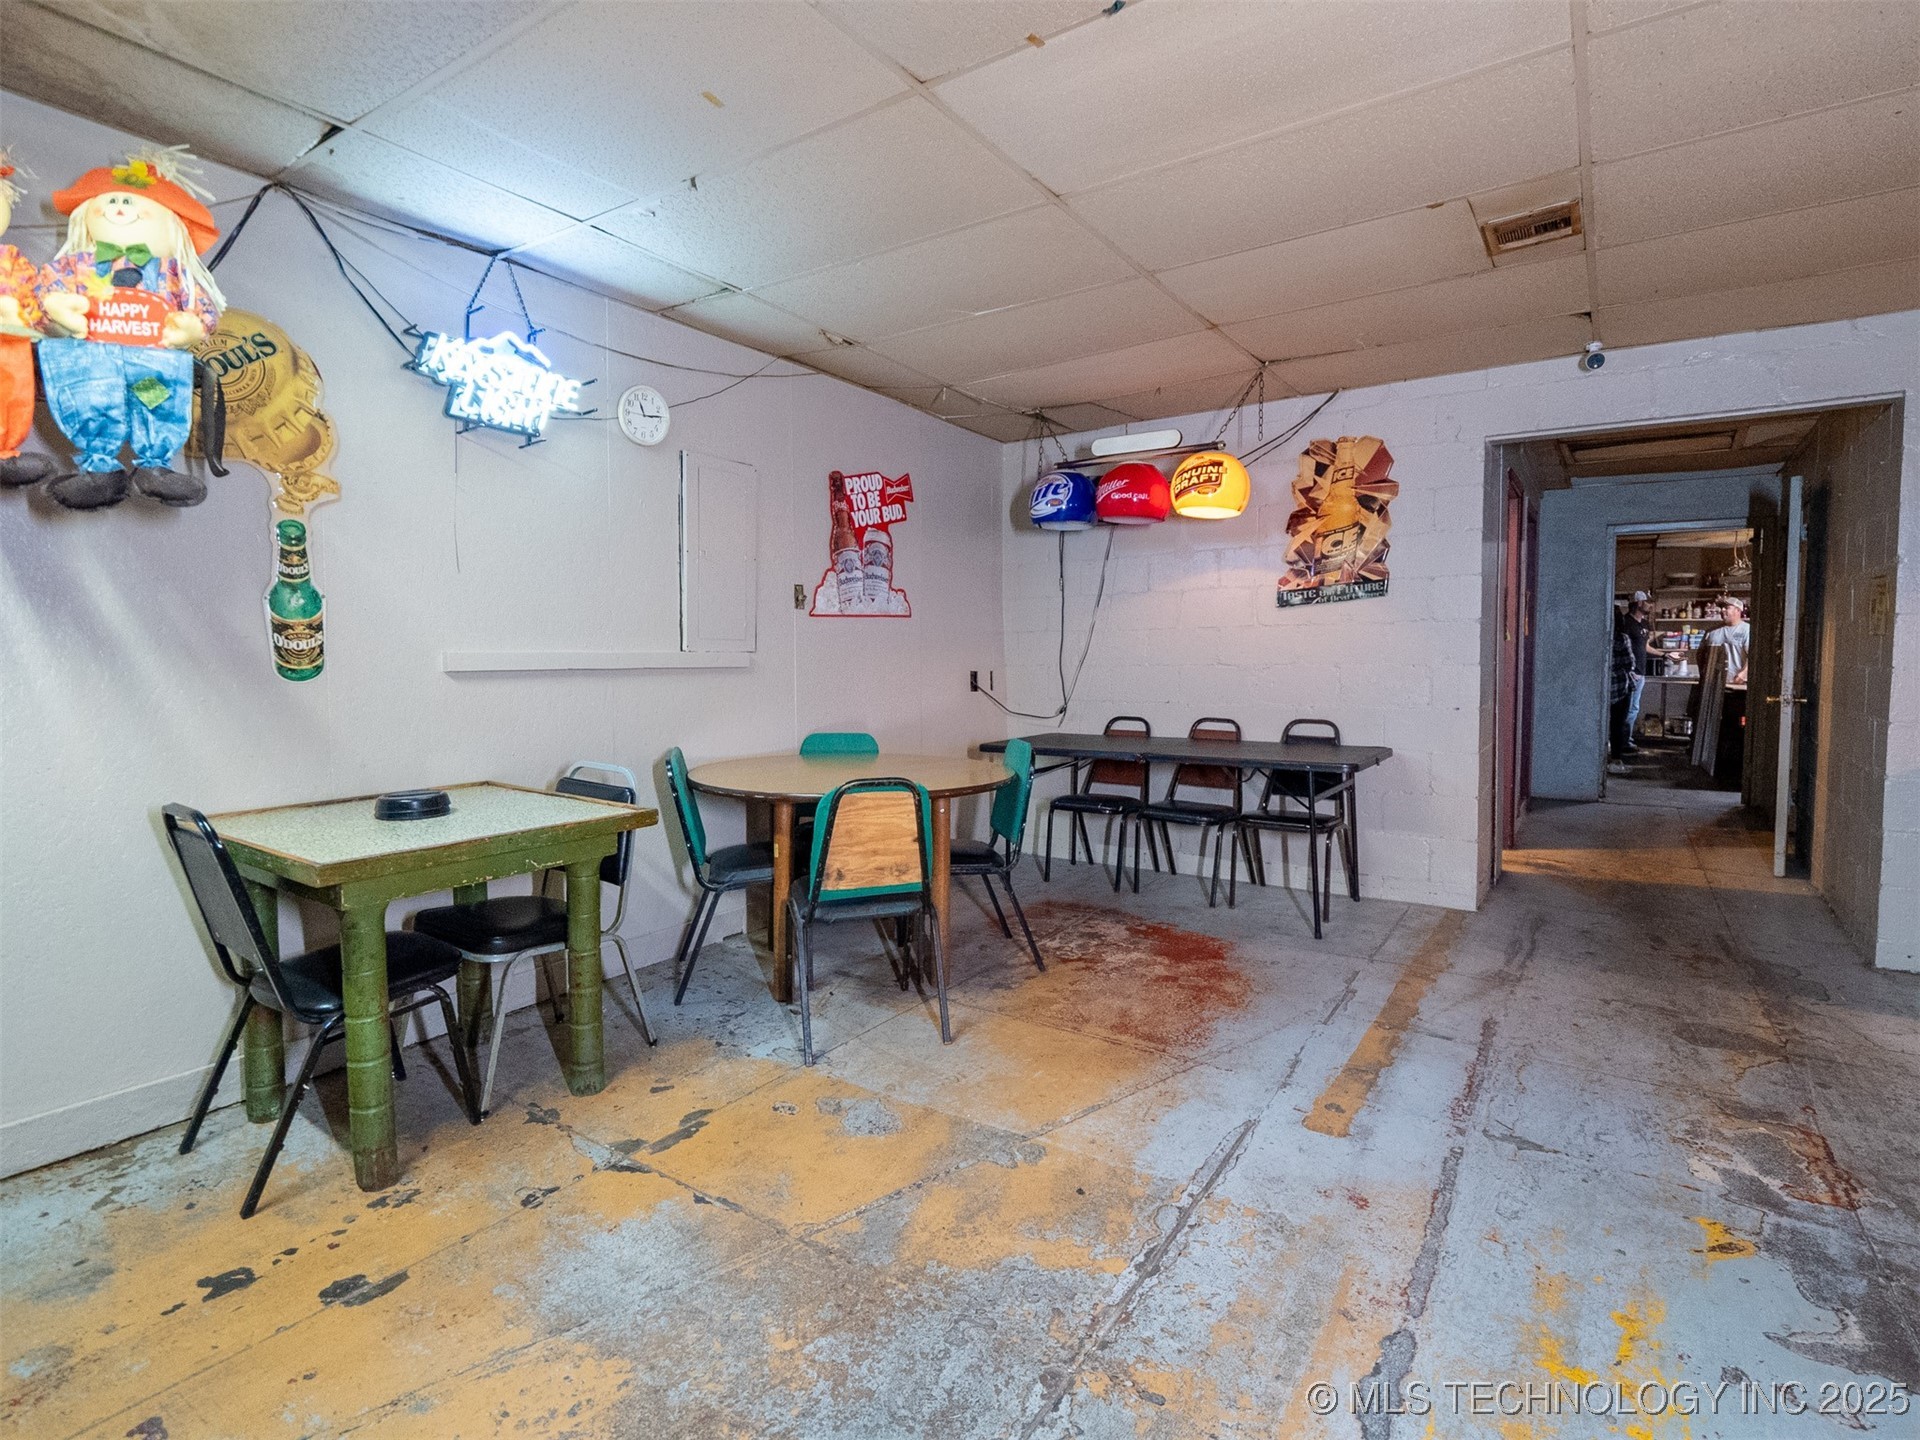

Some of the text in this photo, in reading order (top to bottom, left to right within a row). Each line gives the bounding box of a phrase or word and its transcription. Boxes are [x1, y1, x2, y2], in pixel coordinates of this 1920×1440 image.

[98, 301, 150, 319] HAPPY
[89, 318, 161, 337] HARVEST
[205, 332, 277, 377] OUL'S
[844, 474, 883, 495] PROUD
[1096, 479, 1130, 503] Miller
[1175, 472, 1219, 494] DRAFT
[850, 491, 881, 511] TO BE
[1111, 491, 1132, 500] Good
[851, 503, 906, 528] YOUR BUD.
[273, 631, 323, 651] O'DOUL'S
